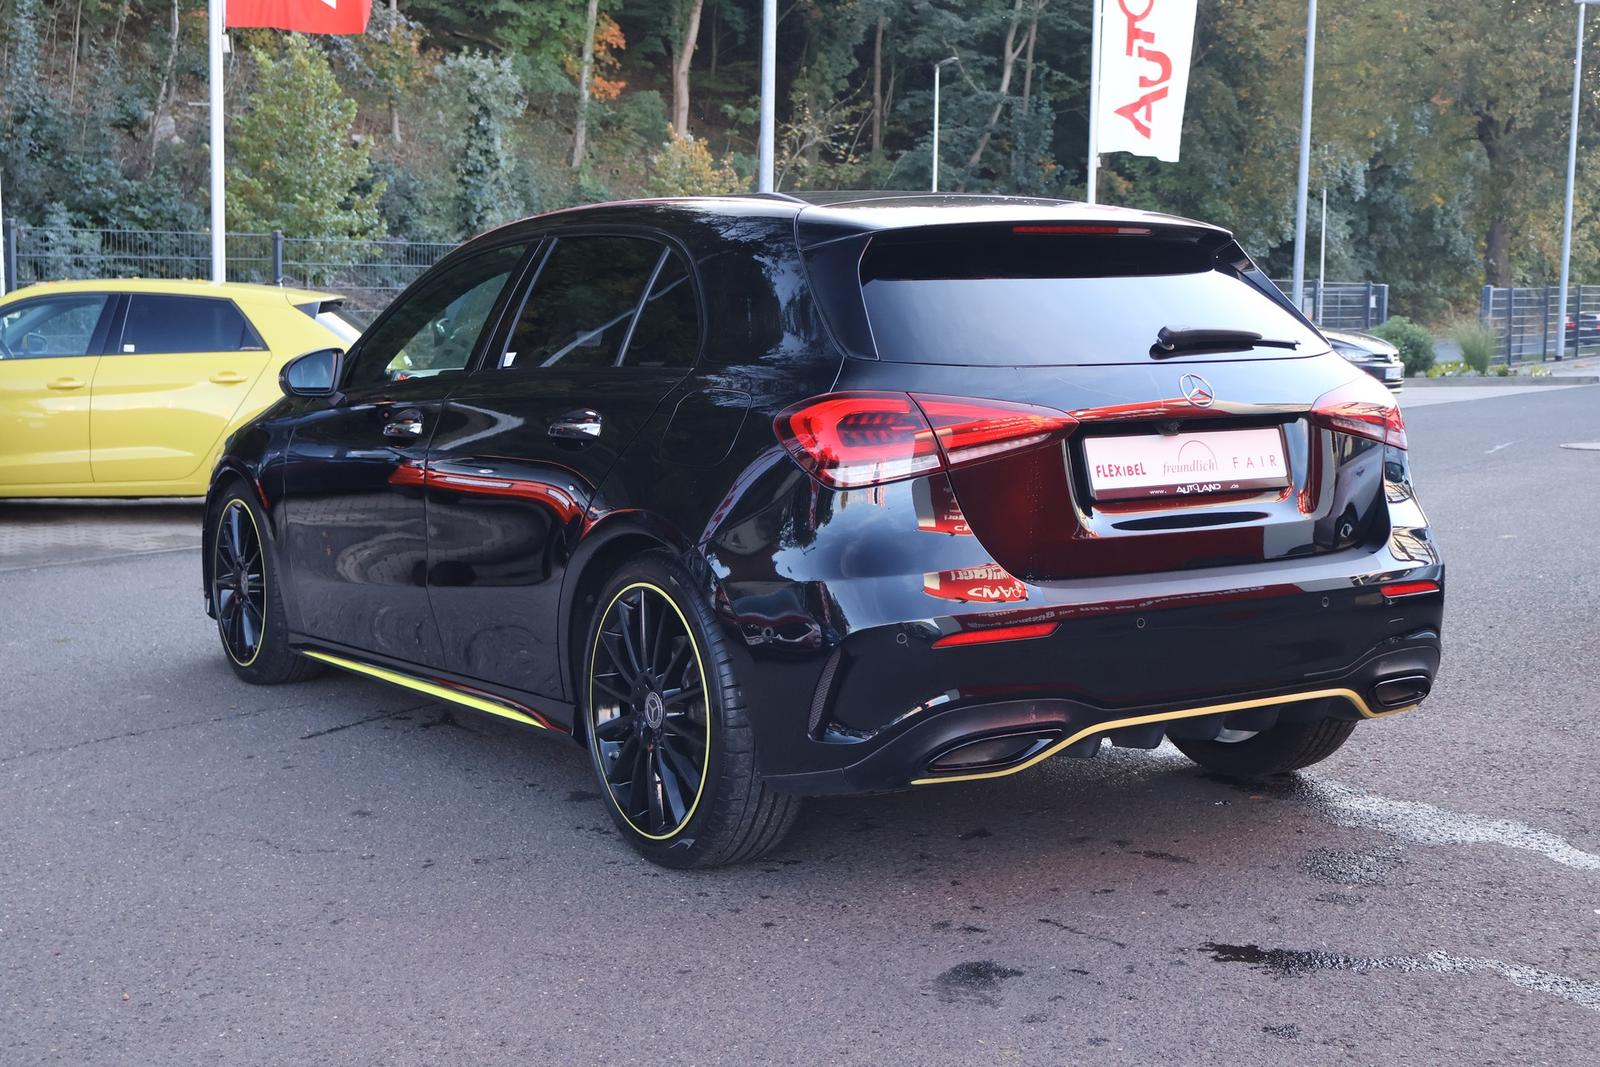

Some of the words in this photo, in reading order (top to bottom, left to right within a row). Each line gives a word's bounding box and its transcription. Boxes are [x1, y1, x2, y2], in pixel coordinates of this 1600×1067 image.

[1095, 462, 1147, 478] FLEXIBEL
[1163, 458, 1216, 477] freundlich
[1176, 483, 1221, 494] AUTOLAND
